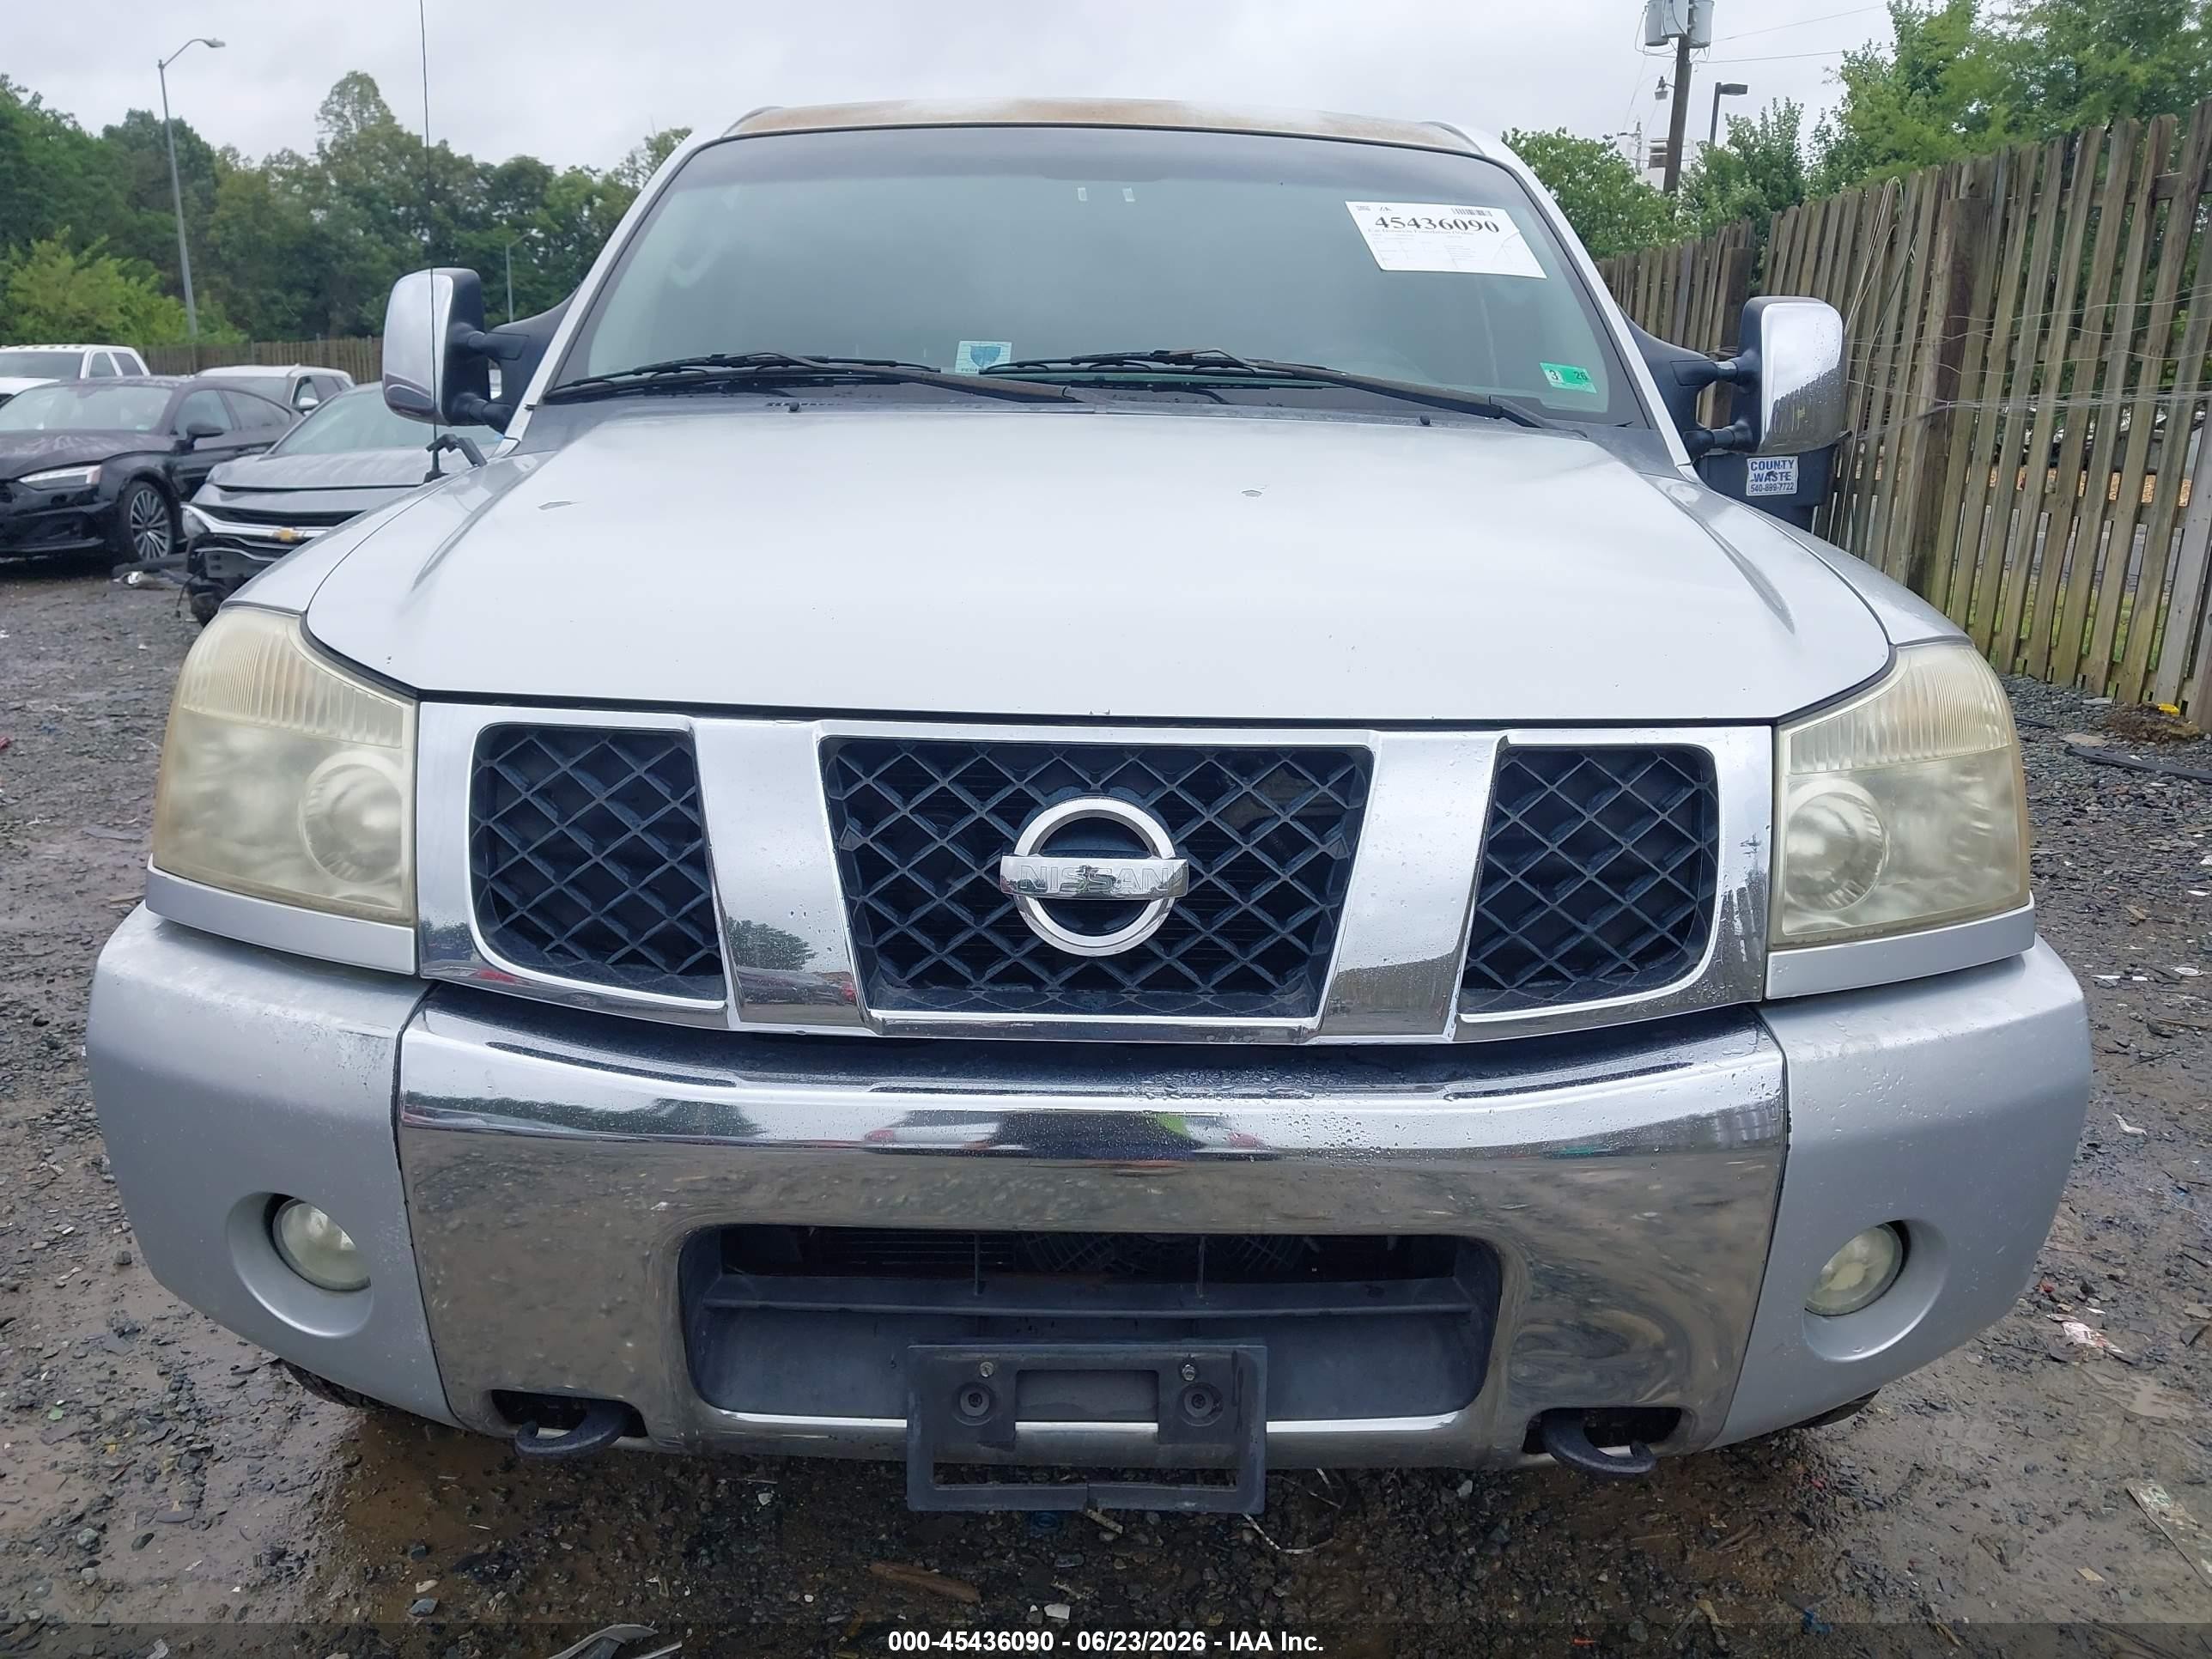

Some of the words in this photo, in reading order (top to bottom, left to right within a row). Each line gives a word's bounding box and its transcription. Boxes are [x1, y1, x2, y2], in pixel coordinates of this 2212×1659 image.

[1375, 216, 1500, 233] 45436090
[1549, 369, 1559, 380] 3
[1750, 459, 1796, 471] COUNTY
[1753, 471, 1792, 483] WASTE
[1017, 864, 1170, 893] NISSAN
